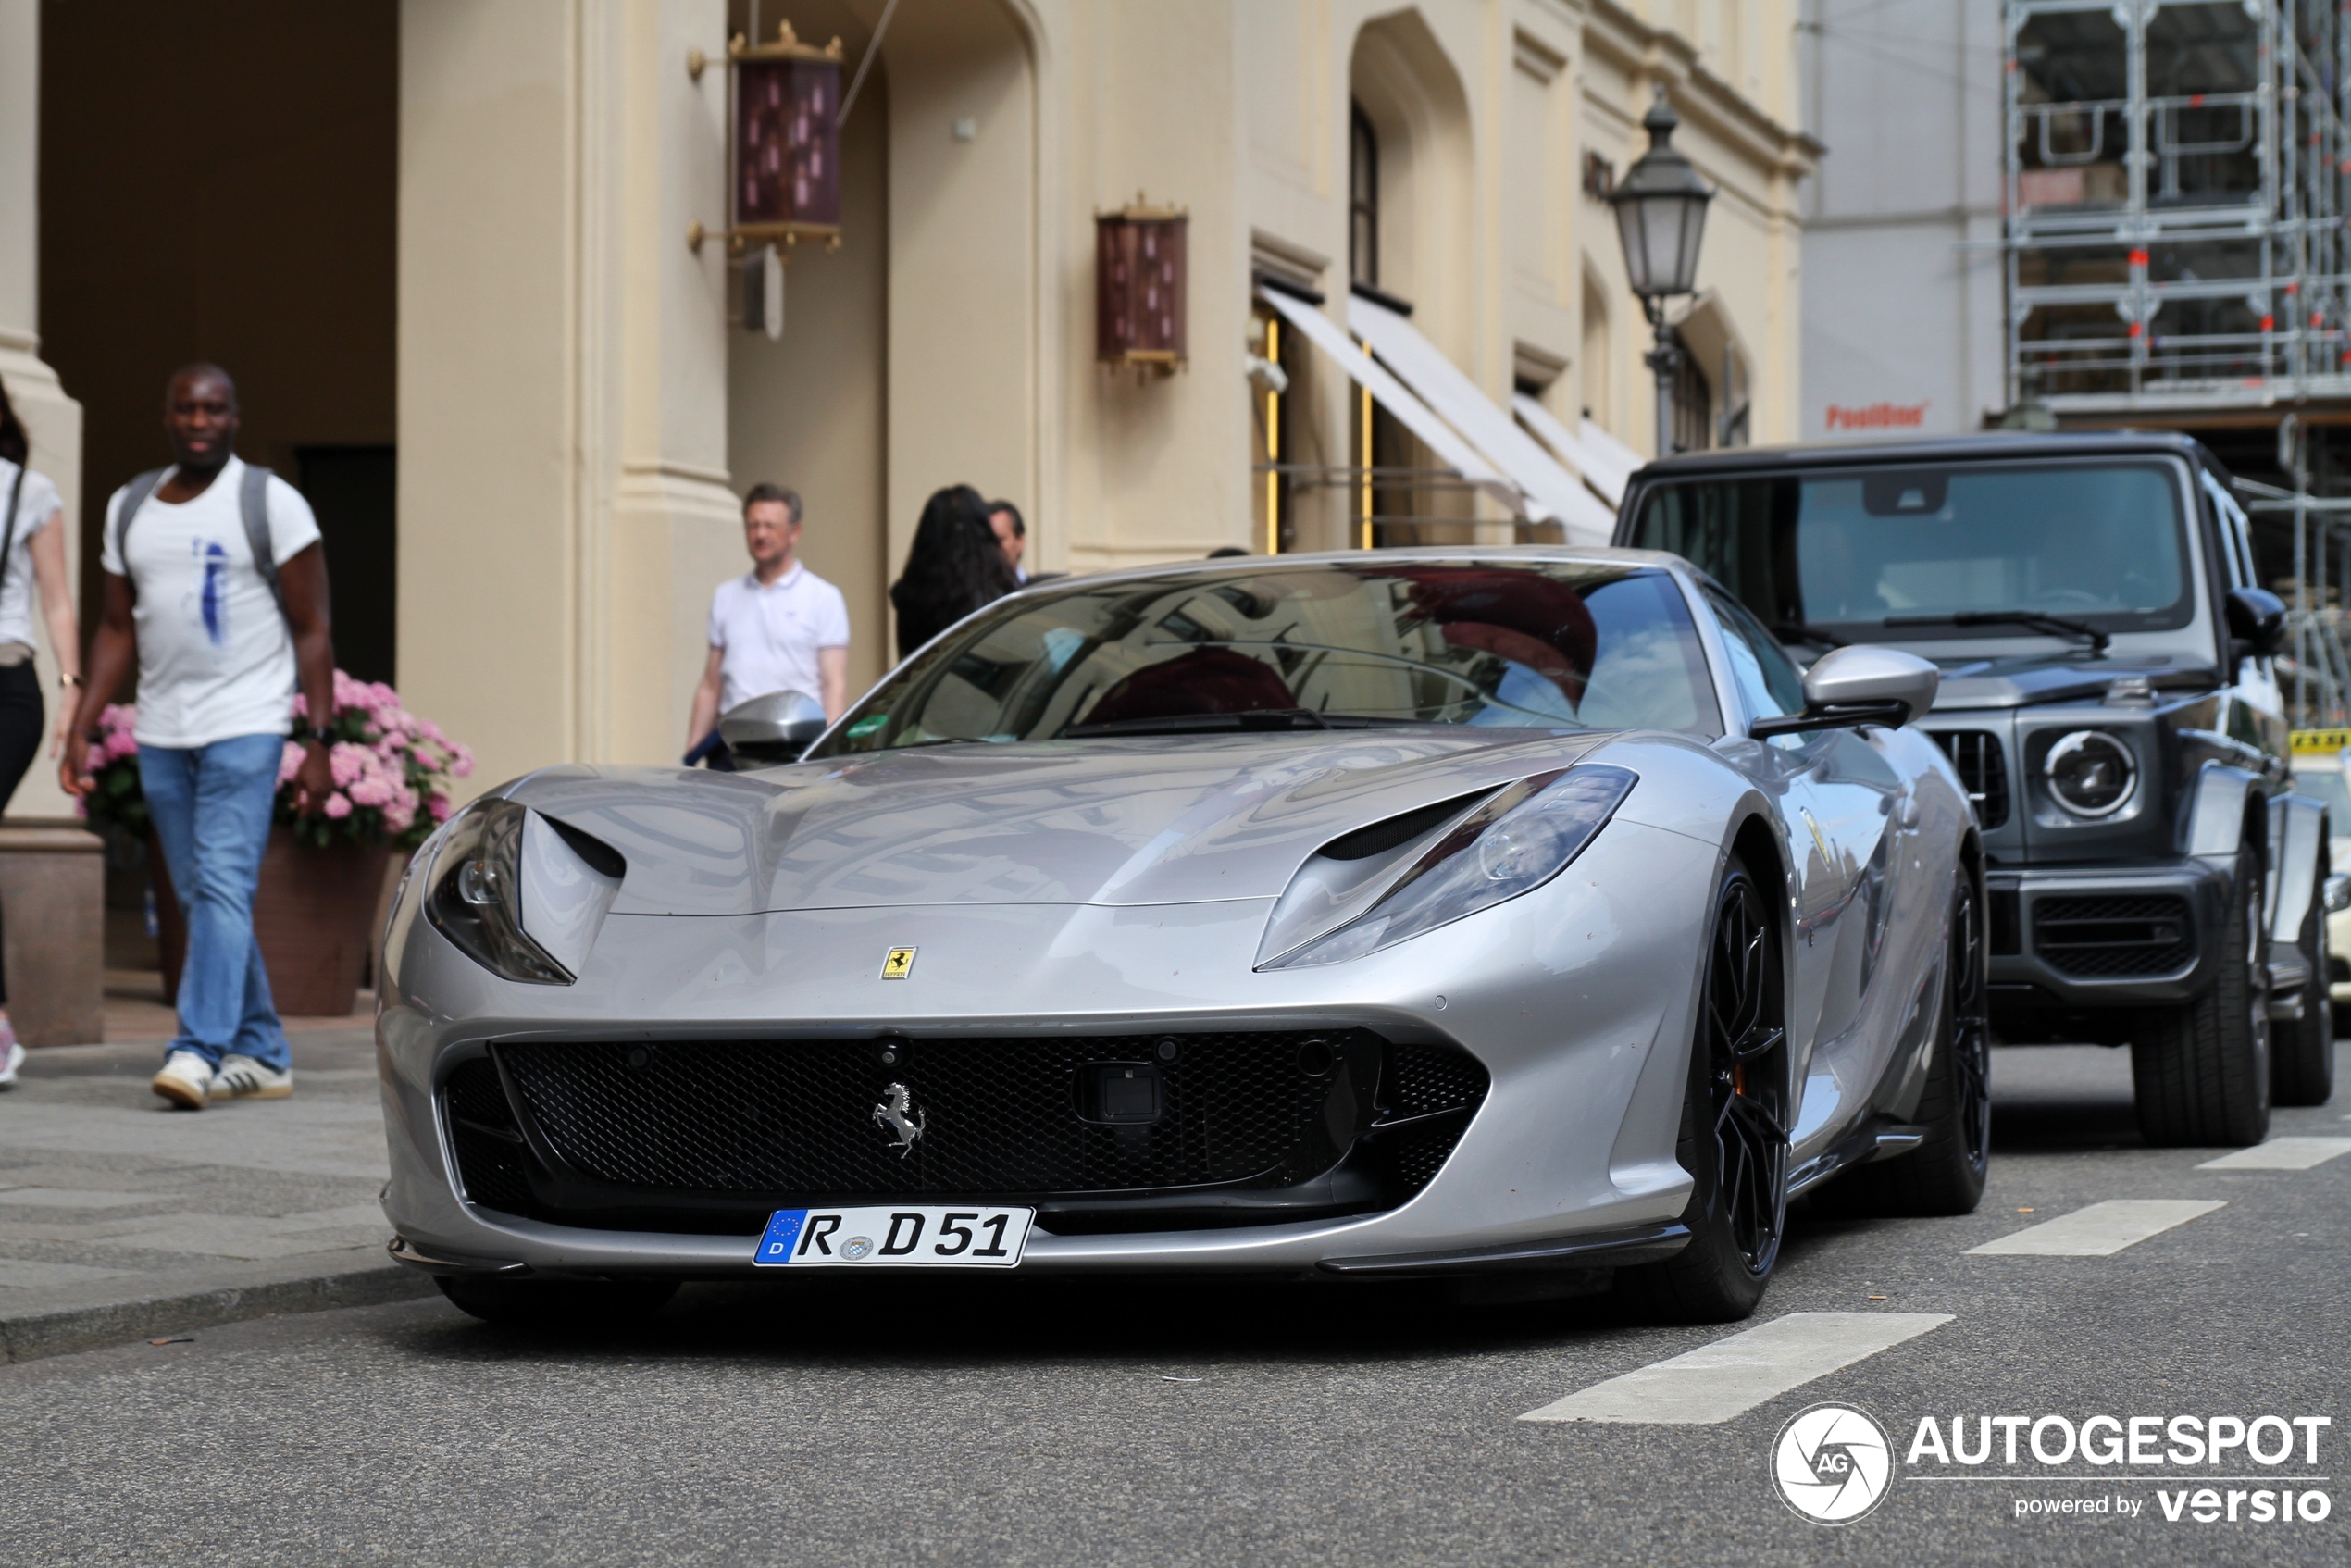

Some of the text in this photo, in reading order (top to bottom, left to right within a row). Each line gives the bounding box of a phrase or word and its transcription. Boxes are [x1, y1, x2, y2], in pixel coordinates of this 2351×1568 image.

[768, 1242, 784, 1255] D
[797, 1214, 842, 1256] R
[878, 1213, 926, 1256] D
[934, 1213, 1010, 1257] 51
